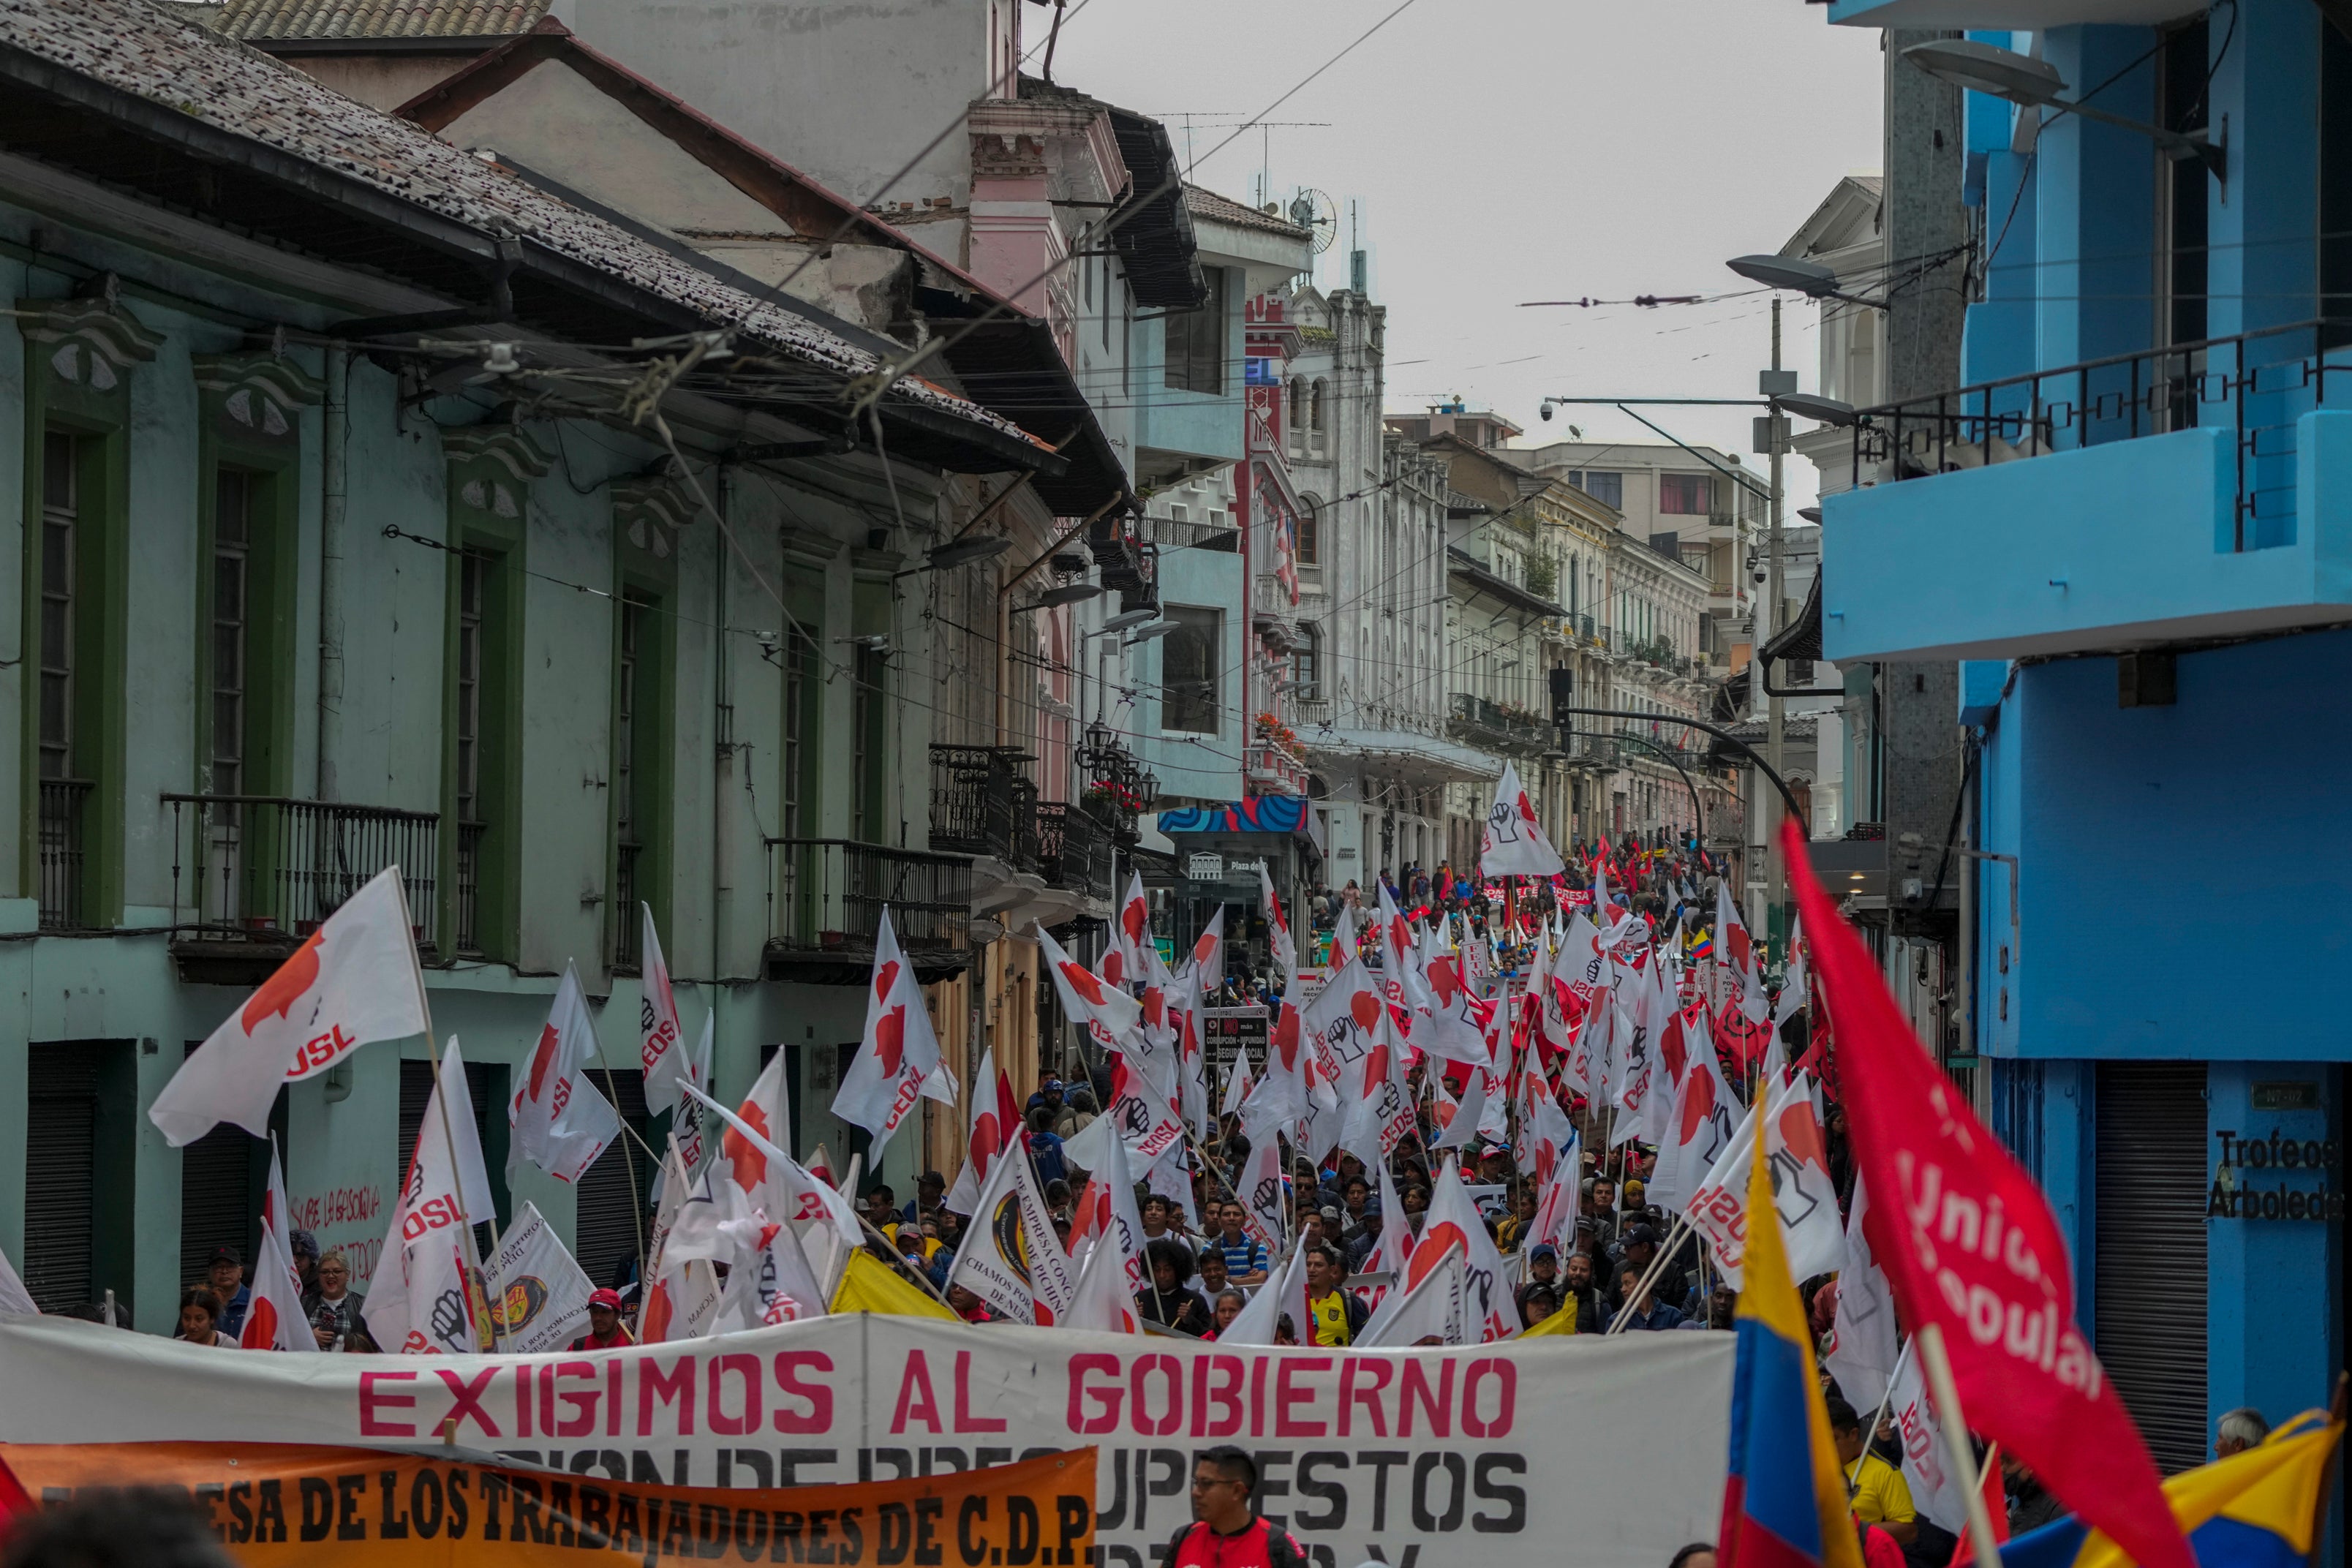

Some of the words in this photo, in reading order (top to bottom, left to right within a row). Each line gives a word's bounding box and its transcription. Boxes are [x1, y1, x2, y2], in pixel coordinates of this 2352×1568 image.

[1232, 862, 1249, 870] Plaza
[1224, 1018, 1238, 1034] NO
[1245, 1047, 1264, 1058] OCIAL
[886, 1065, 927, 1130] CEOSL
[1137, 1118, 1182, 1157] CEOSL
[1022, 1194, 1055, 1259] EMPRESA
[990, 1288, 1006, 1304] DE
[359, 1349, 834, 1438] EXIGIMOS
[889, 1349, 1008, 1434] AL
[1067, 1353, 1518, 1439] GOBIERNO
[300, 1474, 366, 1543] DE
[381, 1466, 470, 1542] LOS
[479, 1466, 864, 1568] TRABAJADORES
[878, 1496, 943, 1565] DE
[957, 1493, 1096, 1567] C.D.P.
